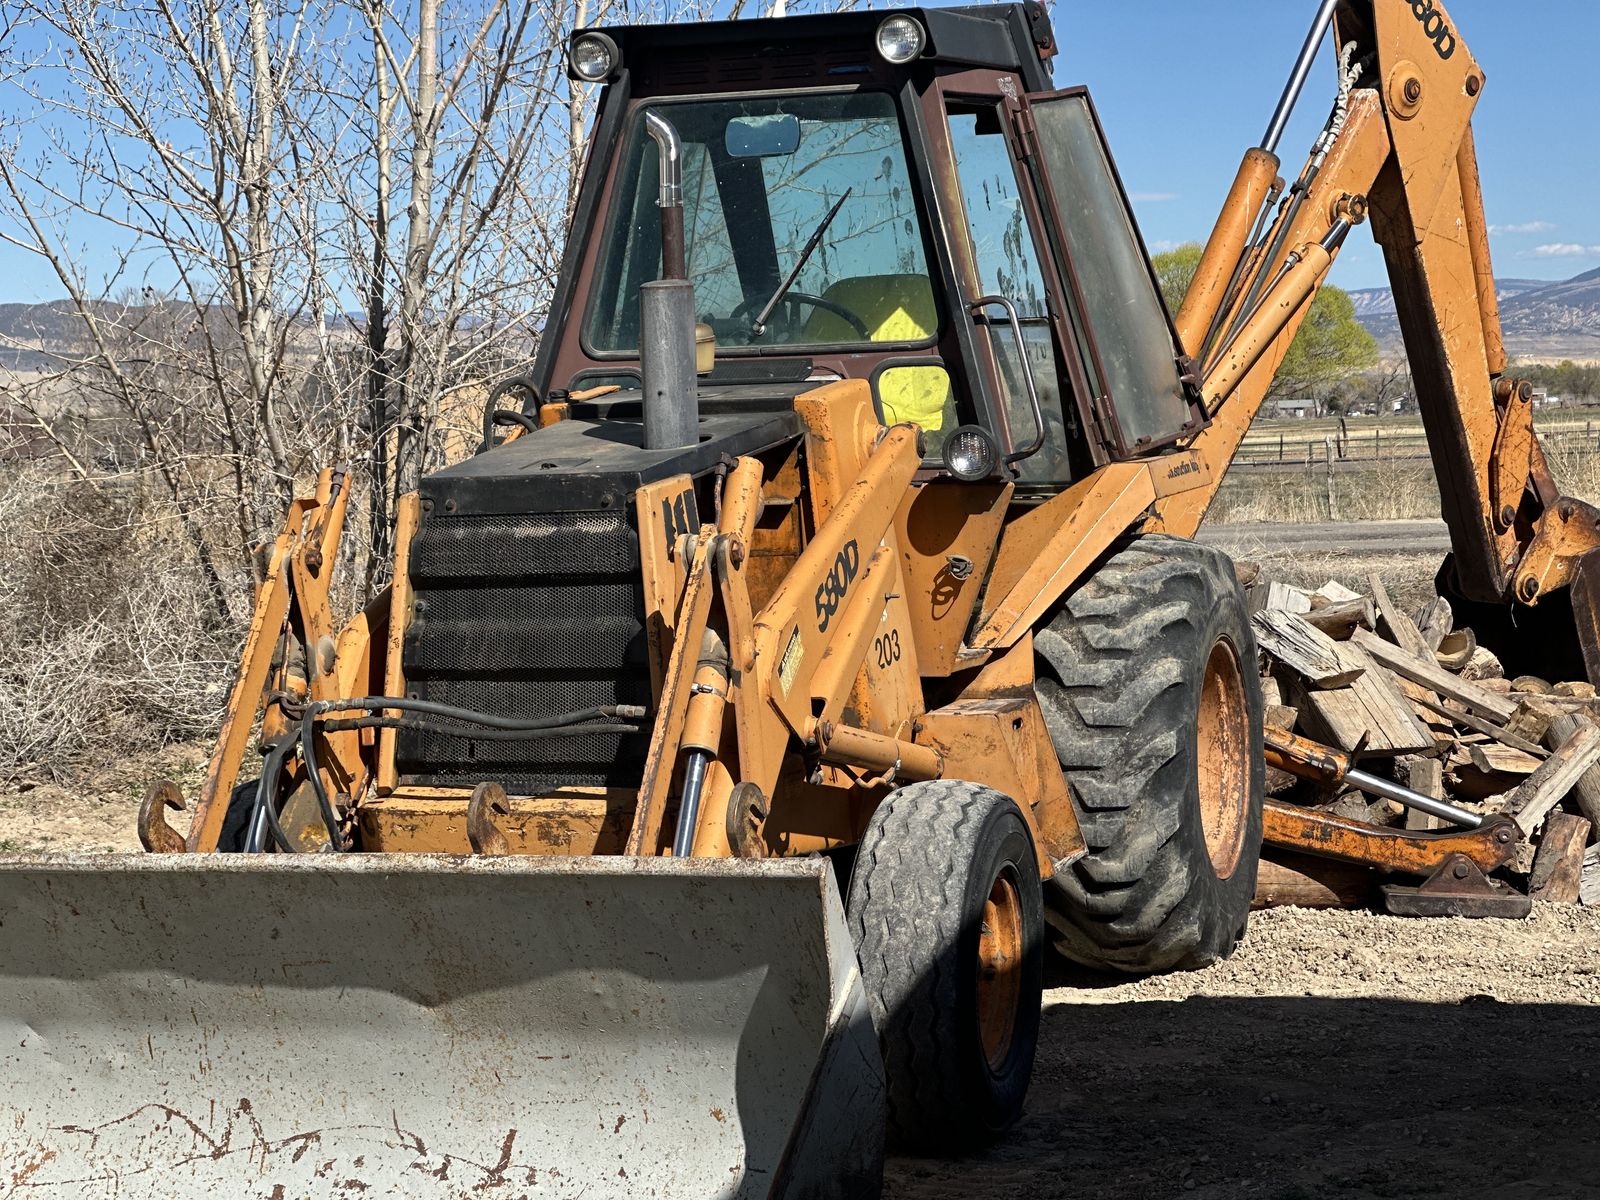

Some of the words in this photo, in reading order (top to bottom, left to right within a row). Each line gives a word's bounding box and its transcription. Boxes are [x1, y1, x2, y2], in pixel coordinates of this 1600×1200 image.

[1405, 0, 1456, 60] 80D
[815, 538, 859, 633] 580D
[875, 629, 901, 670] 203
